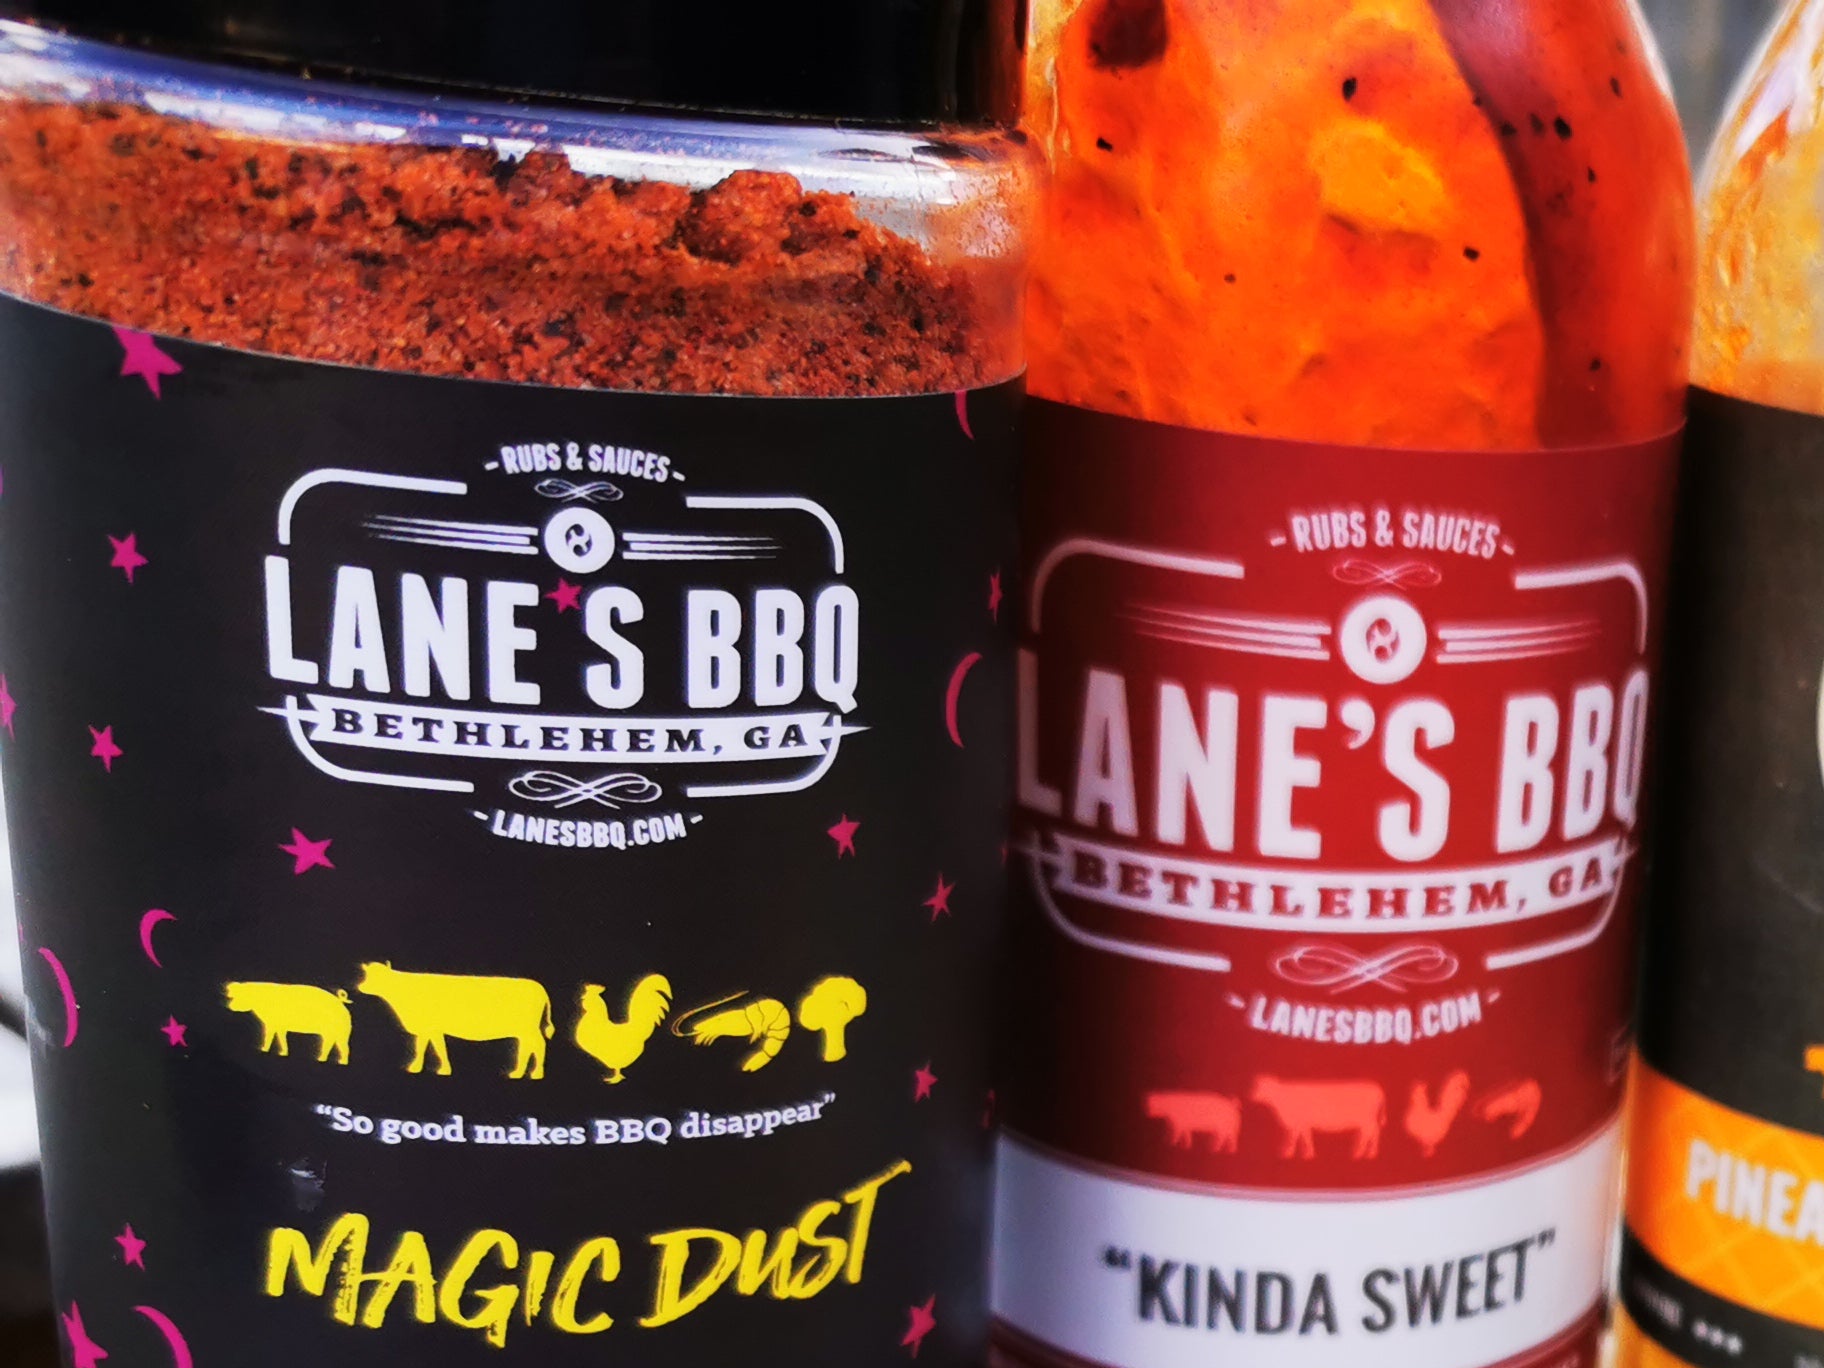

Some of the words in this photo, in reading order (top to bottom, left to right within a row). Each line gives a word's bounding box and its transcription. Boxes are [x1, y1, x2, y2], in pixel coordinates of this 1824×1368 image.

[501, 442, 561, 475] RUBS
[565, 441, 584, 471] &
[588, 443, 671, 483] SAUCES
[1291, 508, 1367, 553] RUBS
[1374, 508, 1395, 547] &
[1401, 510, 1500, 561] SAUCES
[264, 554, 645, 711] LANES
[687, 584, 860, 716] BBQ
[332, 706, 724, 756] BETHLEHEM,
[743, 724, 807, 751] GA
[1016, 646, 1456, 863] LANE'S
[1495, 667, 1650, 855] BBQ
[492, 812, 688, 850] LANESBBQ.COM
[1072, 852, 1529, 920] BETHLEHEM,
[1547, 855, 1604, 899] GA
[1249, 993, 1484, 1046] LANESBBQ.COM
[380, 1115, 467, 1146] good
[474, 1118, 587, 1146] makes
[594, 1117, 674, 1147] BBQ
[263, 1211, 621, 1348] MAGIC
